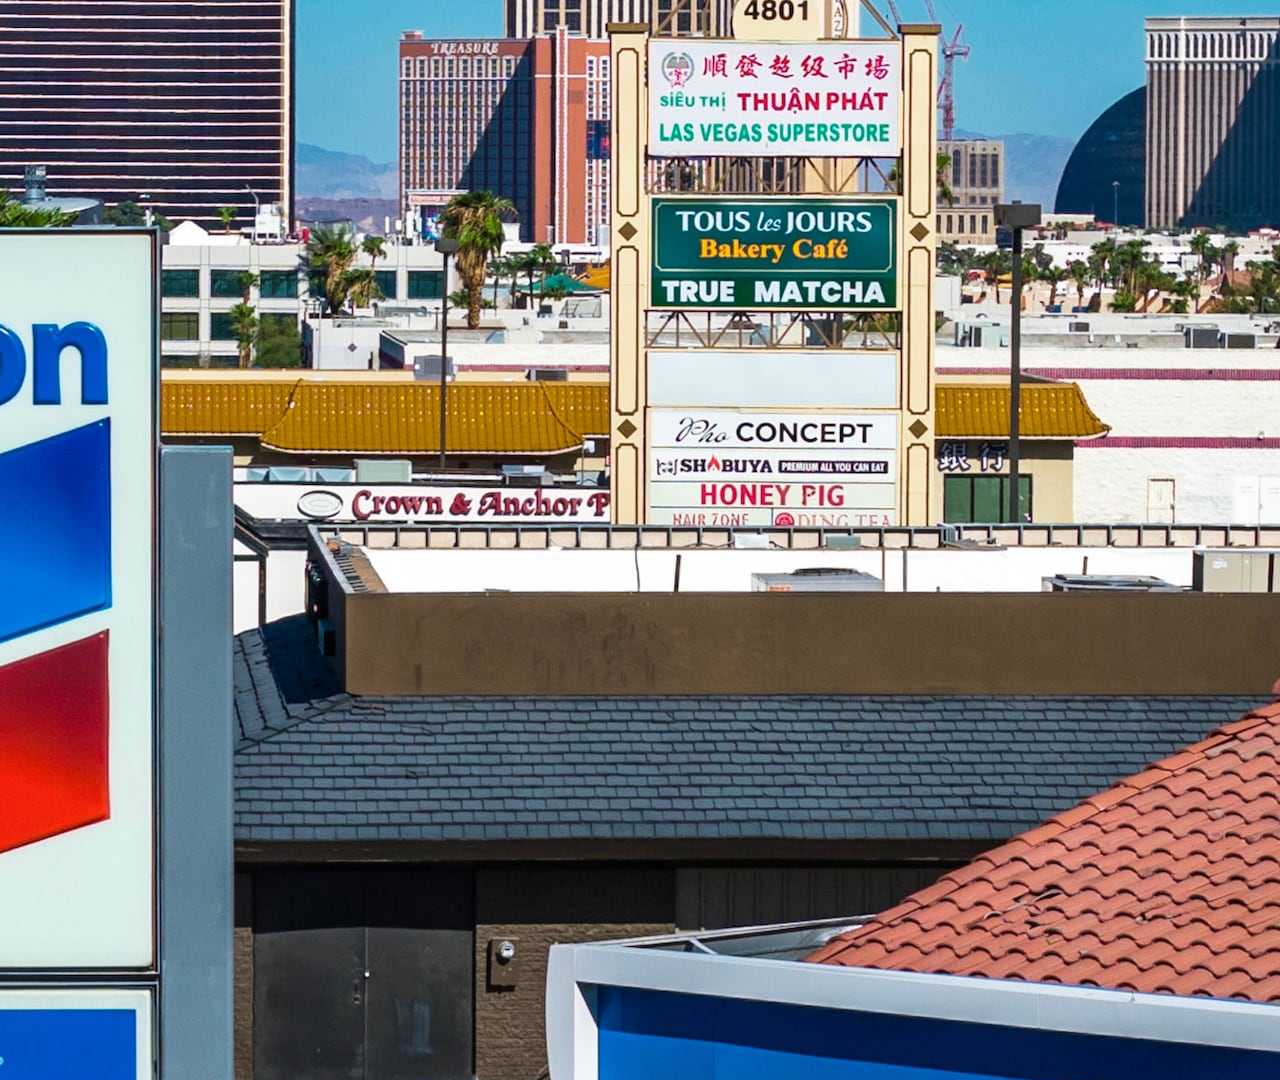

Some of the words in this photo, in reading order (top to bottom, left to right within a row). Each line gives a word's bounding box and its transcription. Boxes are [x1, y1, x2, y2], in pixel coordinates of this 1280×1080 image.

[744, 0, 808, 21] 4801
[430, 43, 499, 55] TREASURE
[737, 87, 820, 114] THUẬN
[826, 87, 888, 111] PHÁT
[659, 123, 694, 142] LAS
[700, 123, 762, 142] VEGAS
[767, 123, 890, 142] SUPERSTORE
[675, 211, 750, 232] TOUS
[756, 211, 782, 232] les
[785, 211, 873, 235] JOURS
[699, 239, 786, 264] Bakery
[792, 238, 849, 259] Café
[661, 280, 735, 302] TRUE
[754, 281, 886, 303] MATCHA
[674, 416, 730, 443] Pho
[736, 422, 873, 443] CONCEPT
[781, 462, 818, 471] PREMIUM
[820, 462, 833, 471] ALL
[835, 462, 852, 471] YOU
[853, 463, 869, 472] CAN
[871, 463, 885, 472] EAT
[937, 442, 1008, 471] 銀行
[352, 490, 443, 519] Crown
[449, 493, 472, 516] &
[477, 489, 582, 517] Anchor
[700, 484, 791, 505] HONEY
[802, 485, 845, 506] PIG
[673, 513, 706, 526] HAIR
[797, 514, 849, 527] DING
